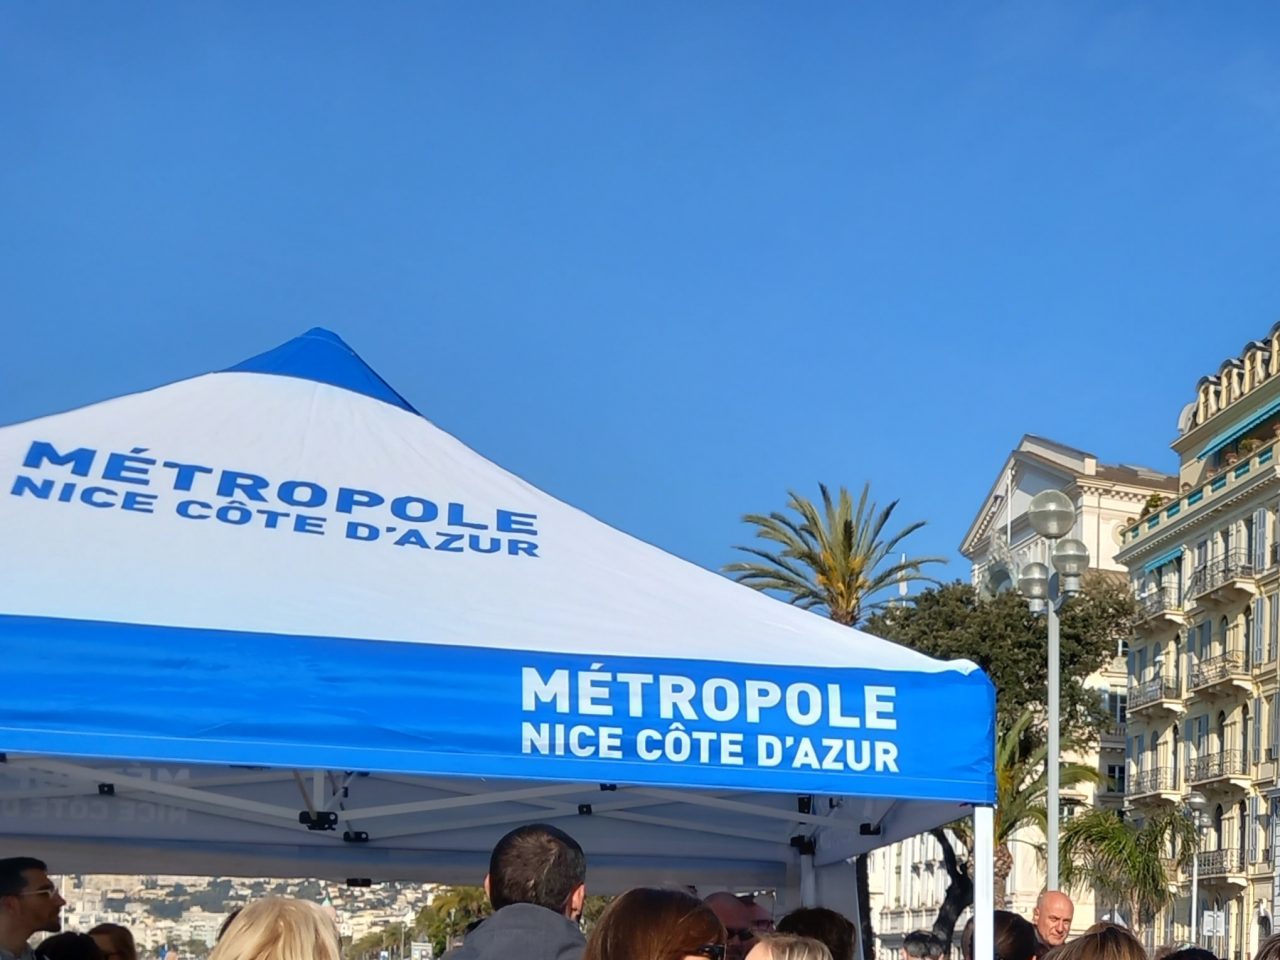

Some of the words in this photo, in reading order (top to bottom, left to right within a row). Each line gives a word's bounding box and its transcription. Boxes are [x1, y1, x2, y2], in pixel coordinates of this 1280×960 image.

[10, 475, 158, 513] NICE
[175, 500, 327, 536] CÔTE
[345, 521, 540, 557] D'AZUR
[22, 440, 538, 536] MÉTROPOLE
[521, 662, 897, 730] MÉTROPOLE
[521, 721, 623, 759] NICE
[636, 721, 744, 765] CÔTE
[757, 734, 900, 773] D'AZUR
